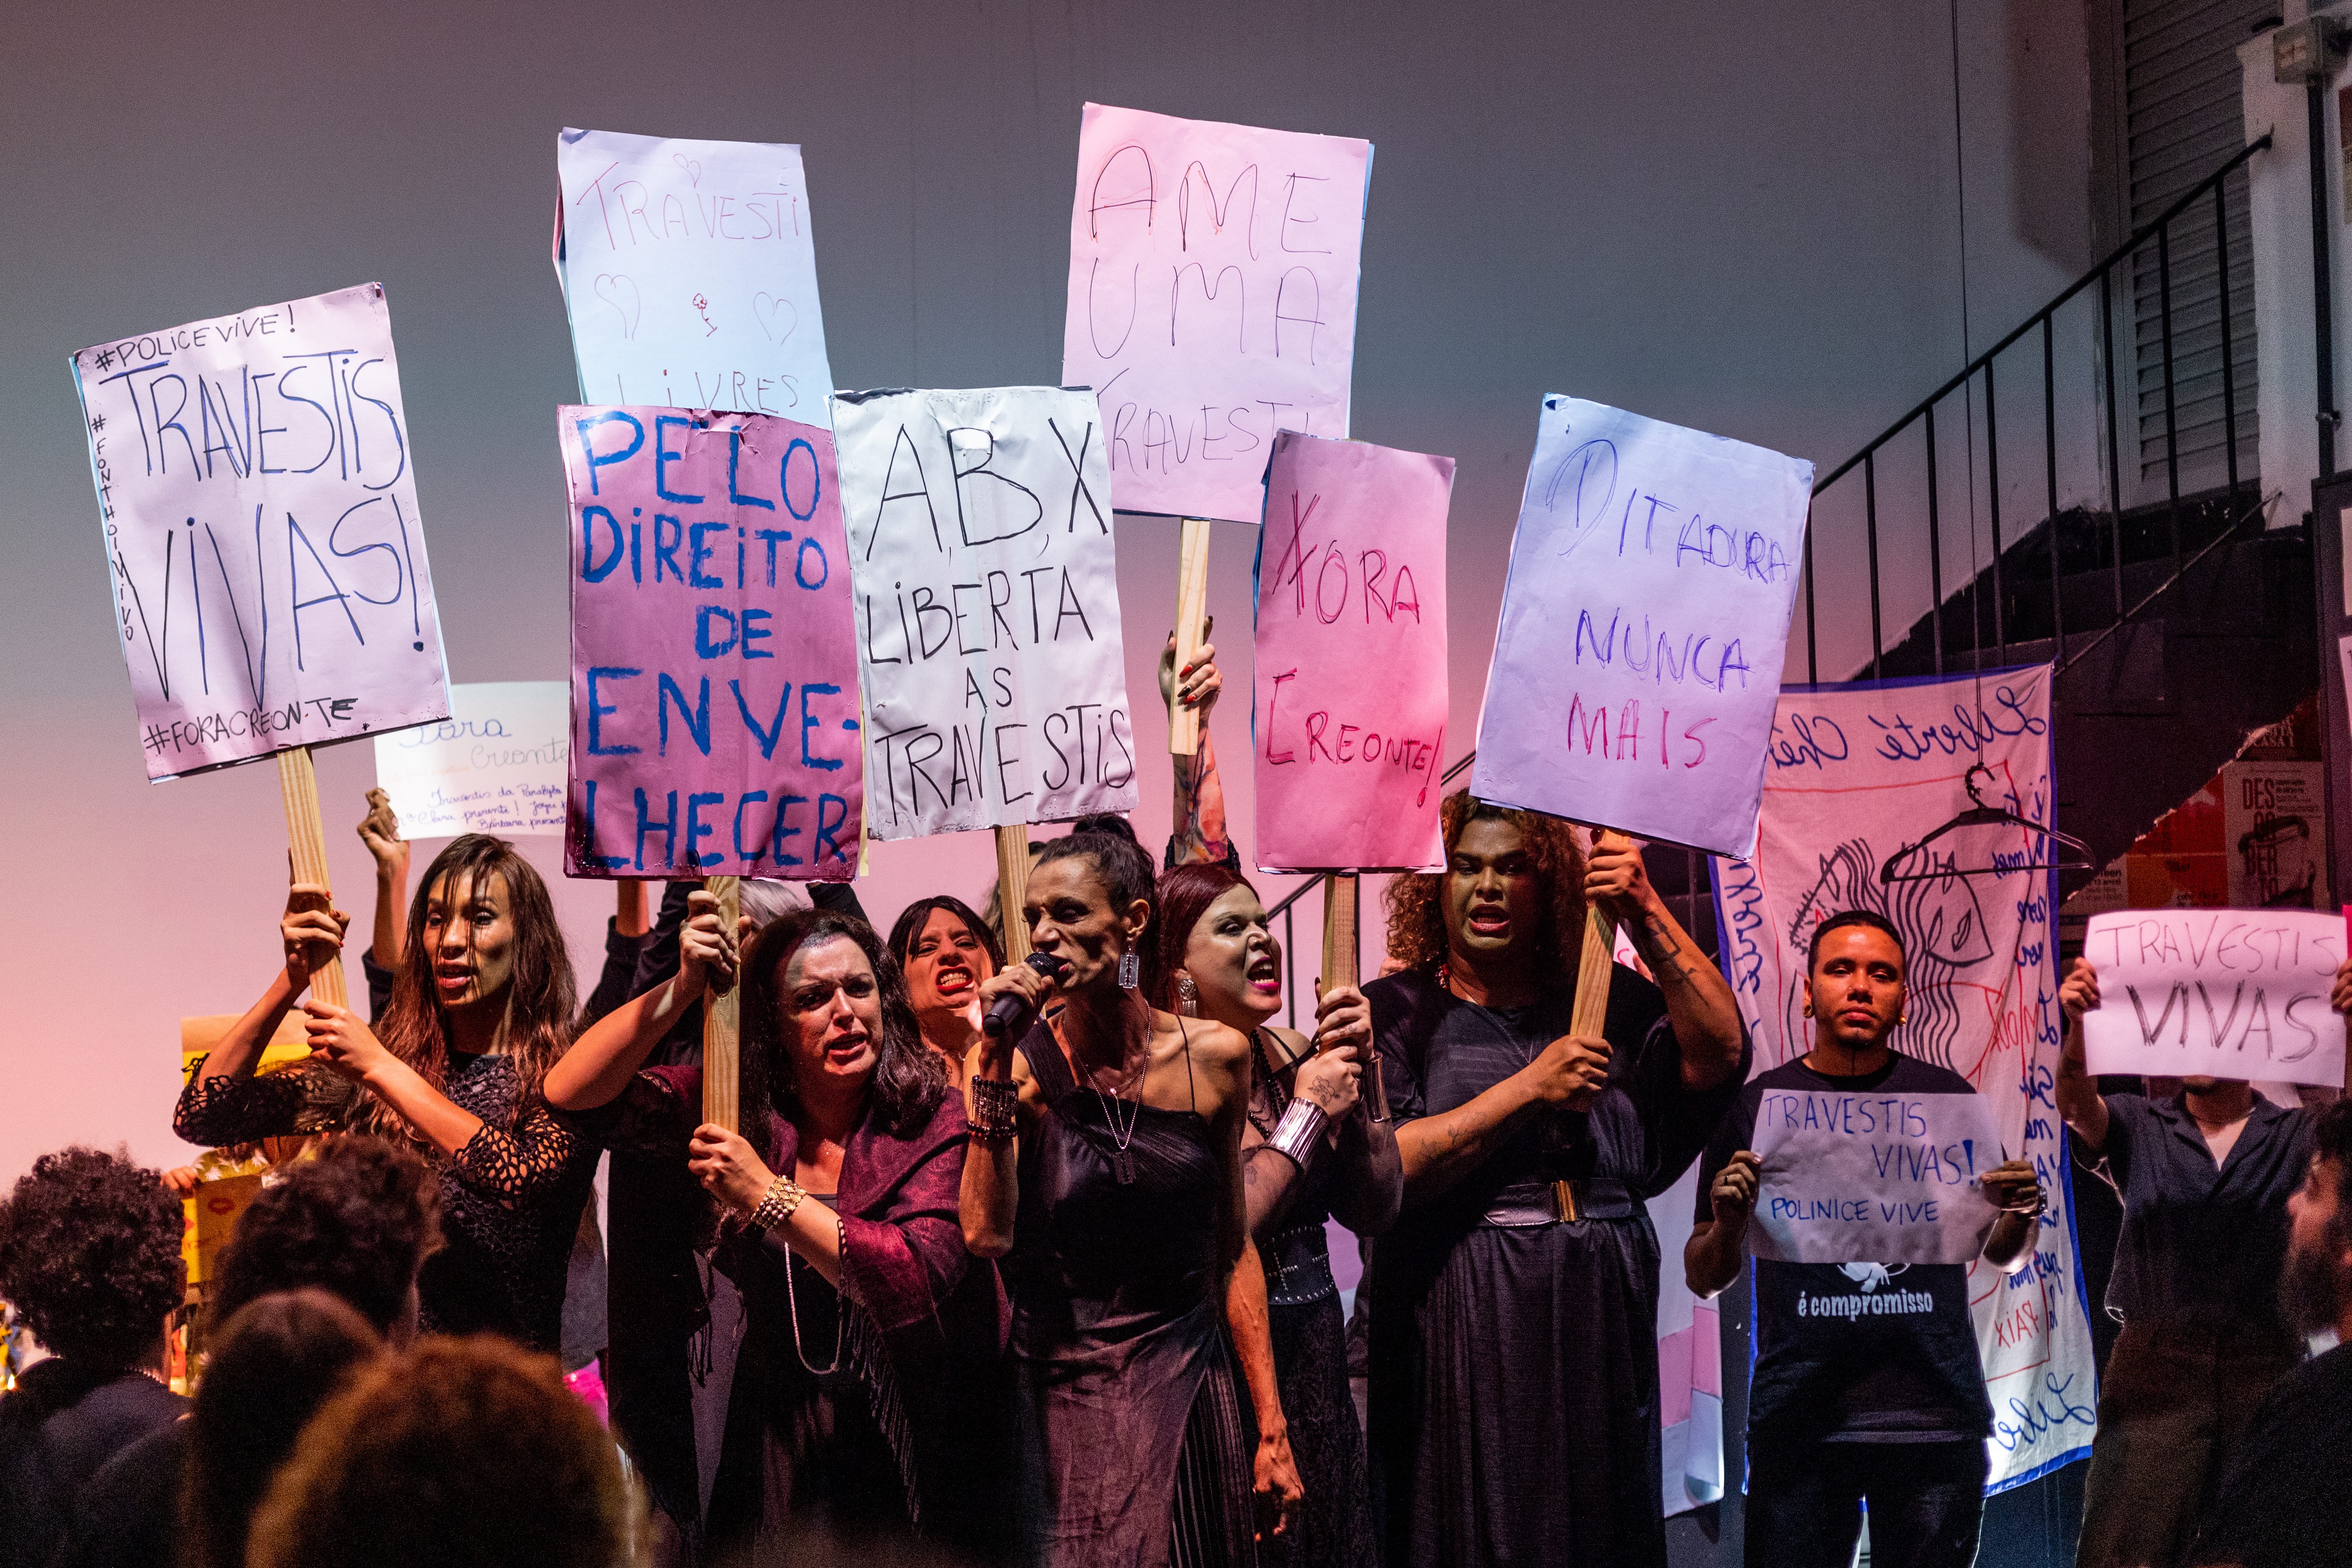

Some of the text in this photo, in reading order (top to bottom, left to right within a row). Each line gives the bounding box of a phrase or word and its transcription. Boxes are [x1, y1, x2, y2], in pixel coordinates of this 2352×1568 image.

[1083, 139, 1332, 261] AME
[1089, 257, 1325, 366] UMA
[576, 410, 821, 521] PELO
[1546, 440, 1791, 583] DITADURA
[695, 605, 774, 659] DE
[1576, 607, 1754, 692] NUNCA
[587, 667, 860, 770] ENVE-
[966, 667, 1012, 713] AS
[1568, 692, 1719, 769] MAIS
[498, 786, 514, 797] da
[585, 780, 848, 870] LHECER
[2243, 778, 2274, 809] DES
[2095, 915, 2340, 976] TRAVESTIS
[2125, 979, 2321, 1063] VIVAS
[1765, 1095, 1927, 1137] TRAVESTIS
[1872, 1140, 1974, 1186] VIVAS!
[1771, 1198, 1939, 1225] POLINICE VIVE
[1798, 1289, 1933, 1322] é compromisso
